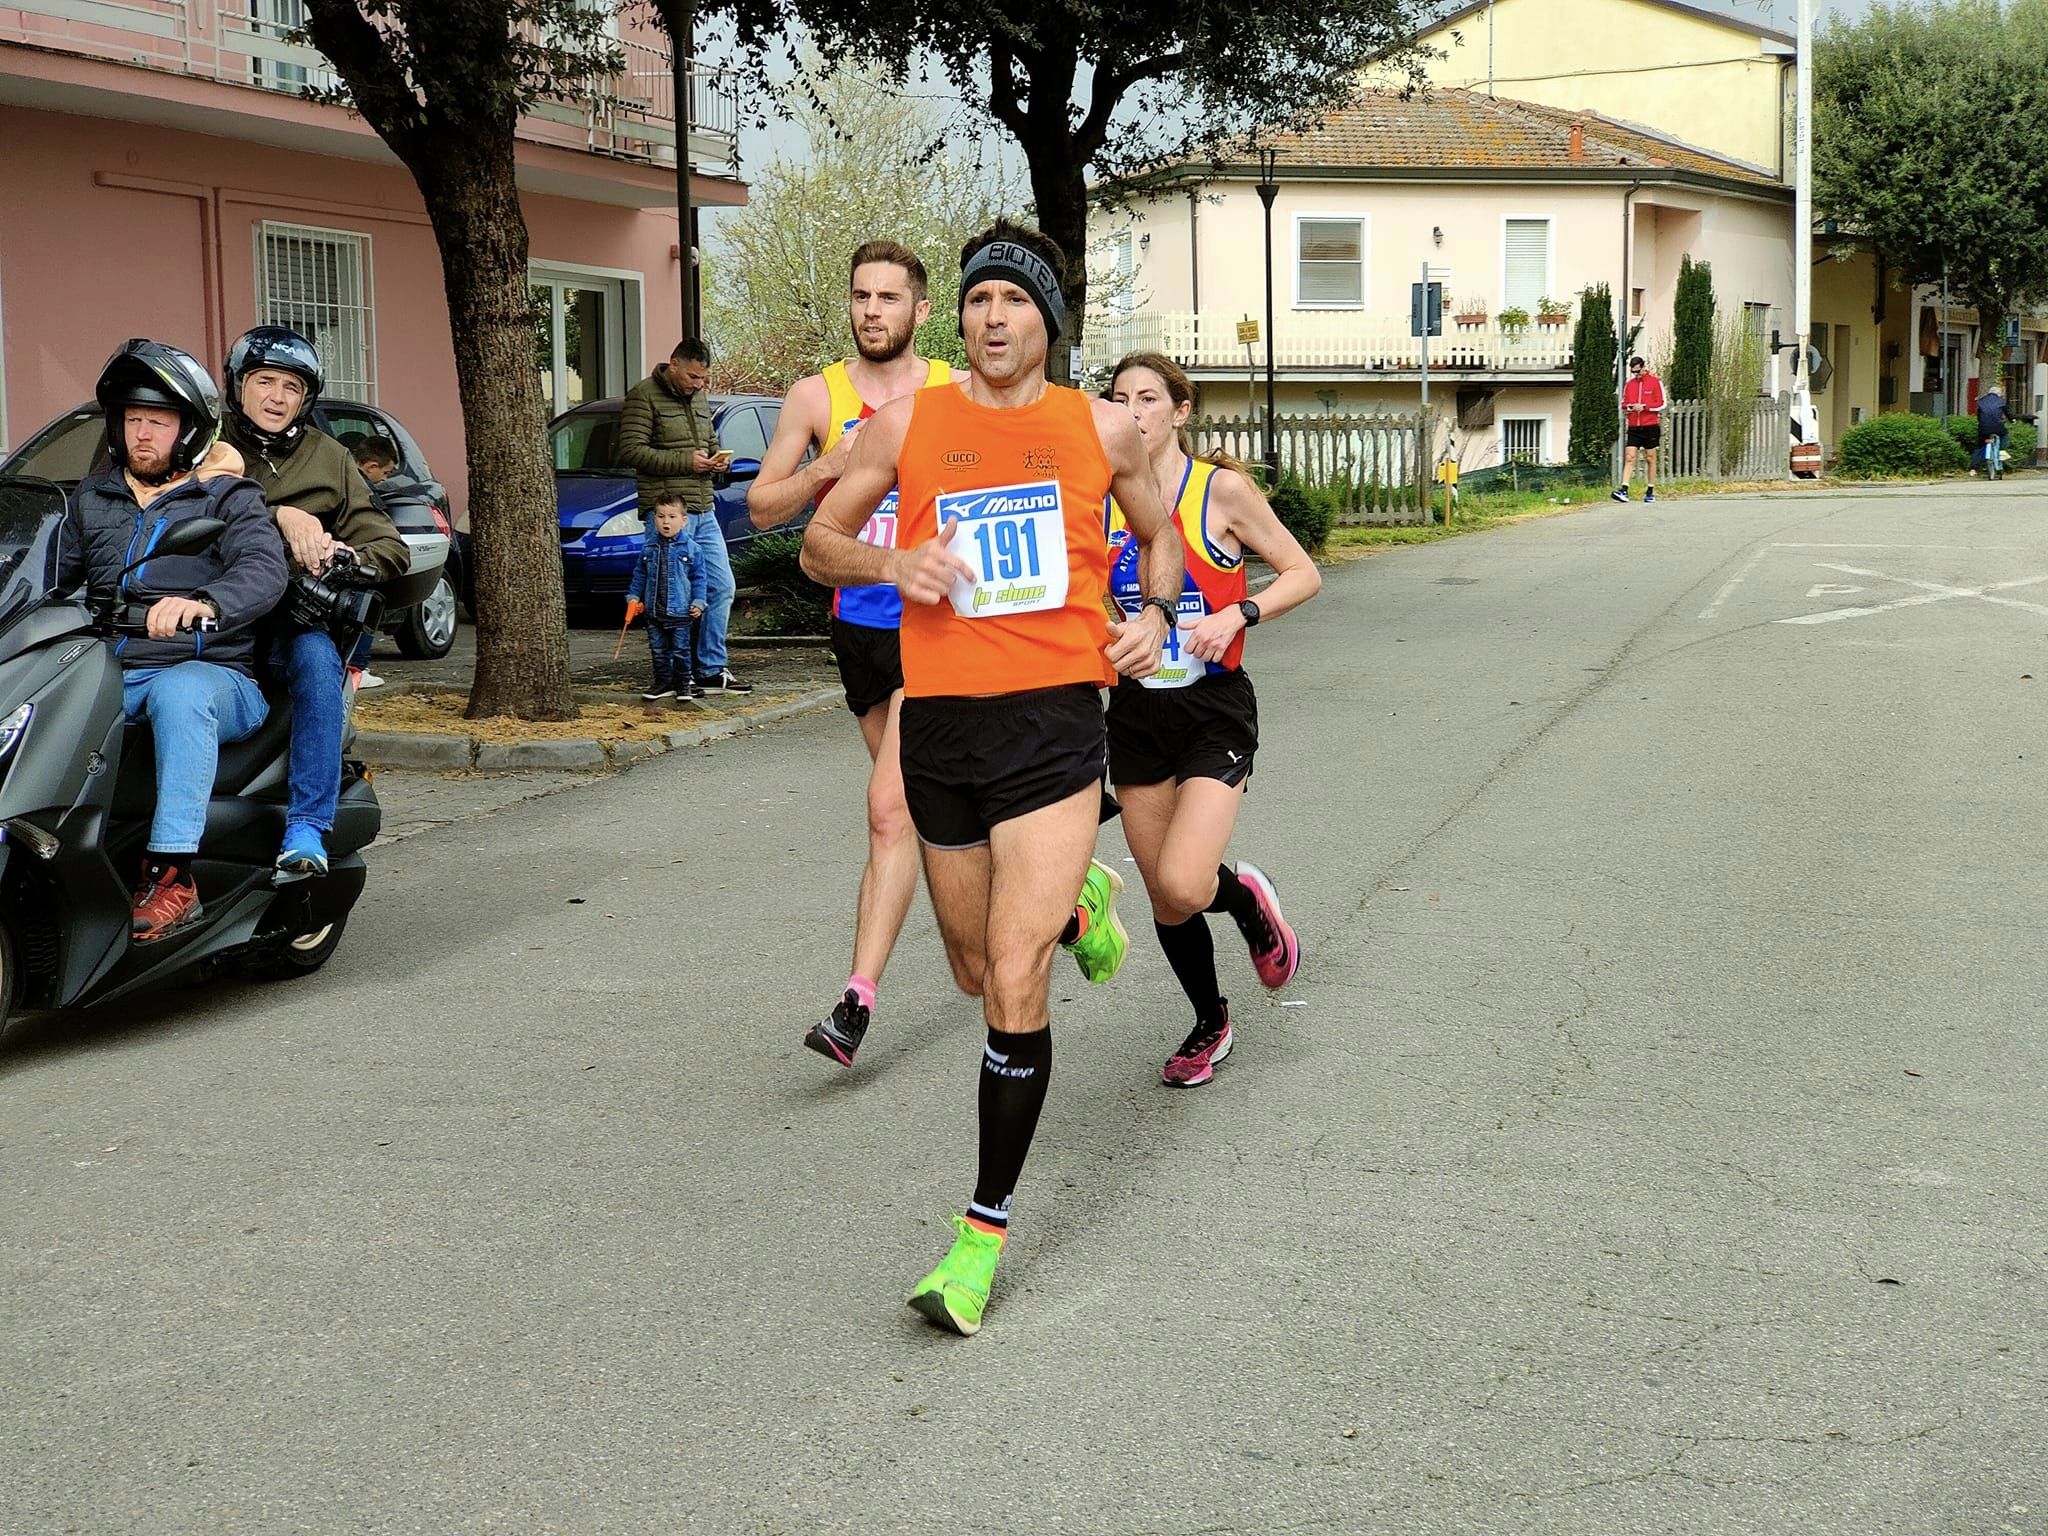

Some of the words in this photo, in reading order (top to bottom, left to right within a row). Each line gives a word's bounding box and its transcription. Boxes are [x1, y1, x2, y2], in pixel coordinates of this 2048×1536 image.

[989, 244, 1057, 302] BIOTEX
[946, 453, 976, 463] LUCCI
[974, 517, 1040, 582] 191
